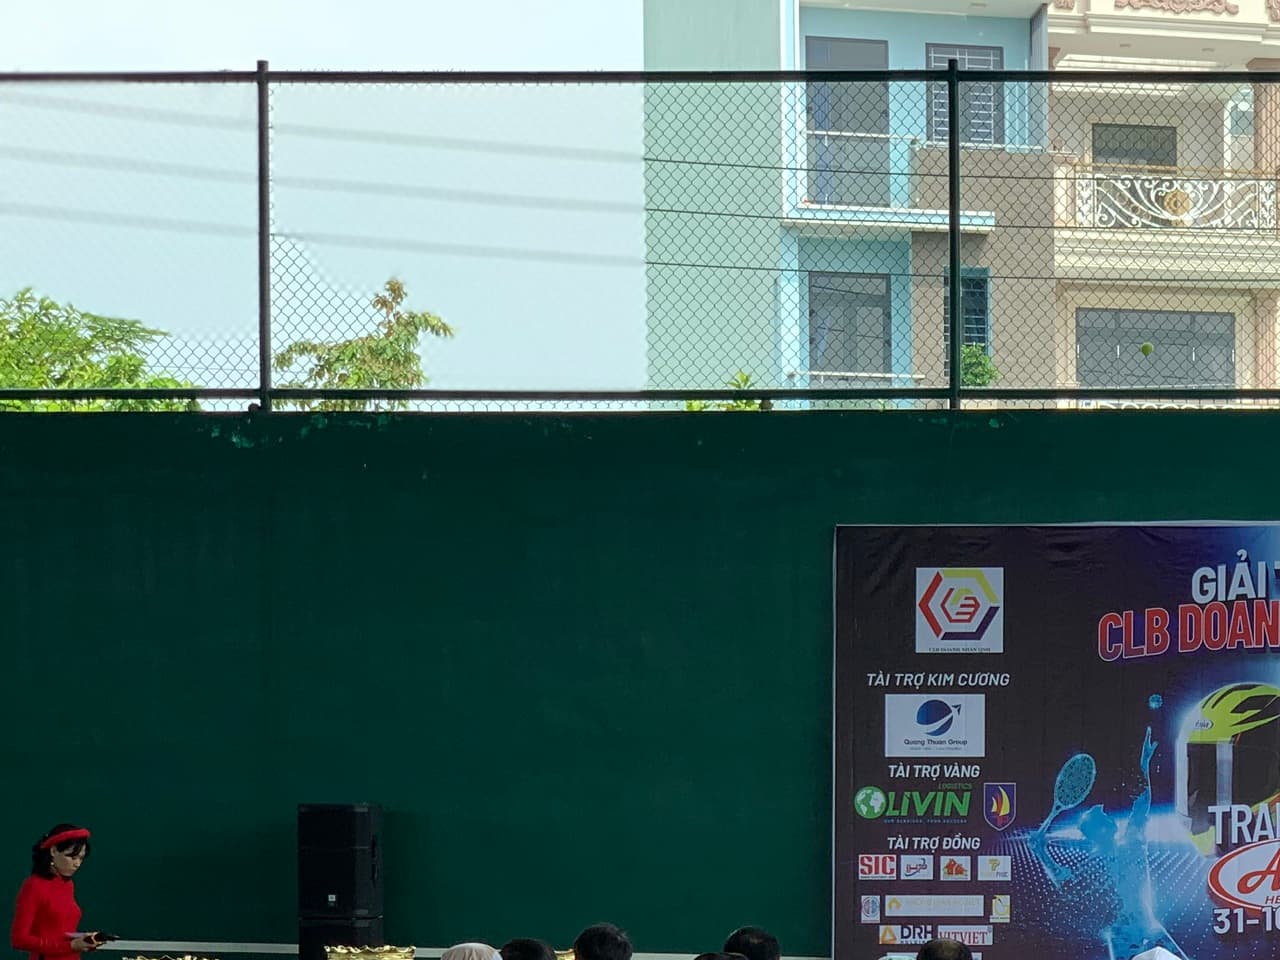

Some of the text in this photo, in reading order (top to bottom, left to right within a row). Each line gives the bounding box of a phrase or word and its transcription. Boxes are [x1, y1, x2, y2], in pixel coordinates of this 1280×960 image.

[1191, 549, 1267, 604] GIẢI
[1098, 606, 1170, 661] CLB
[867, 670, 1010, 689] TÀI TRỢ KIM CƯƠNG
[888, 762, 980, 781] TÀI TRỢ VÀNG
[887, 832, 981, 853] TÀI TRỢ ĐỒNG
[859, 855, 897, 876] SIC
